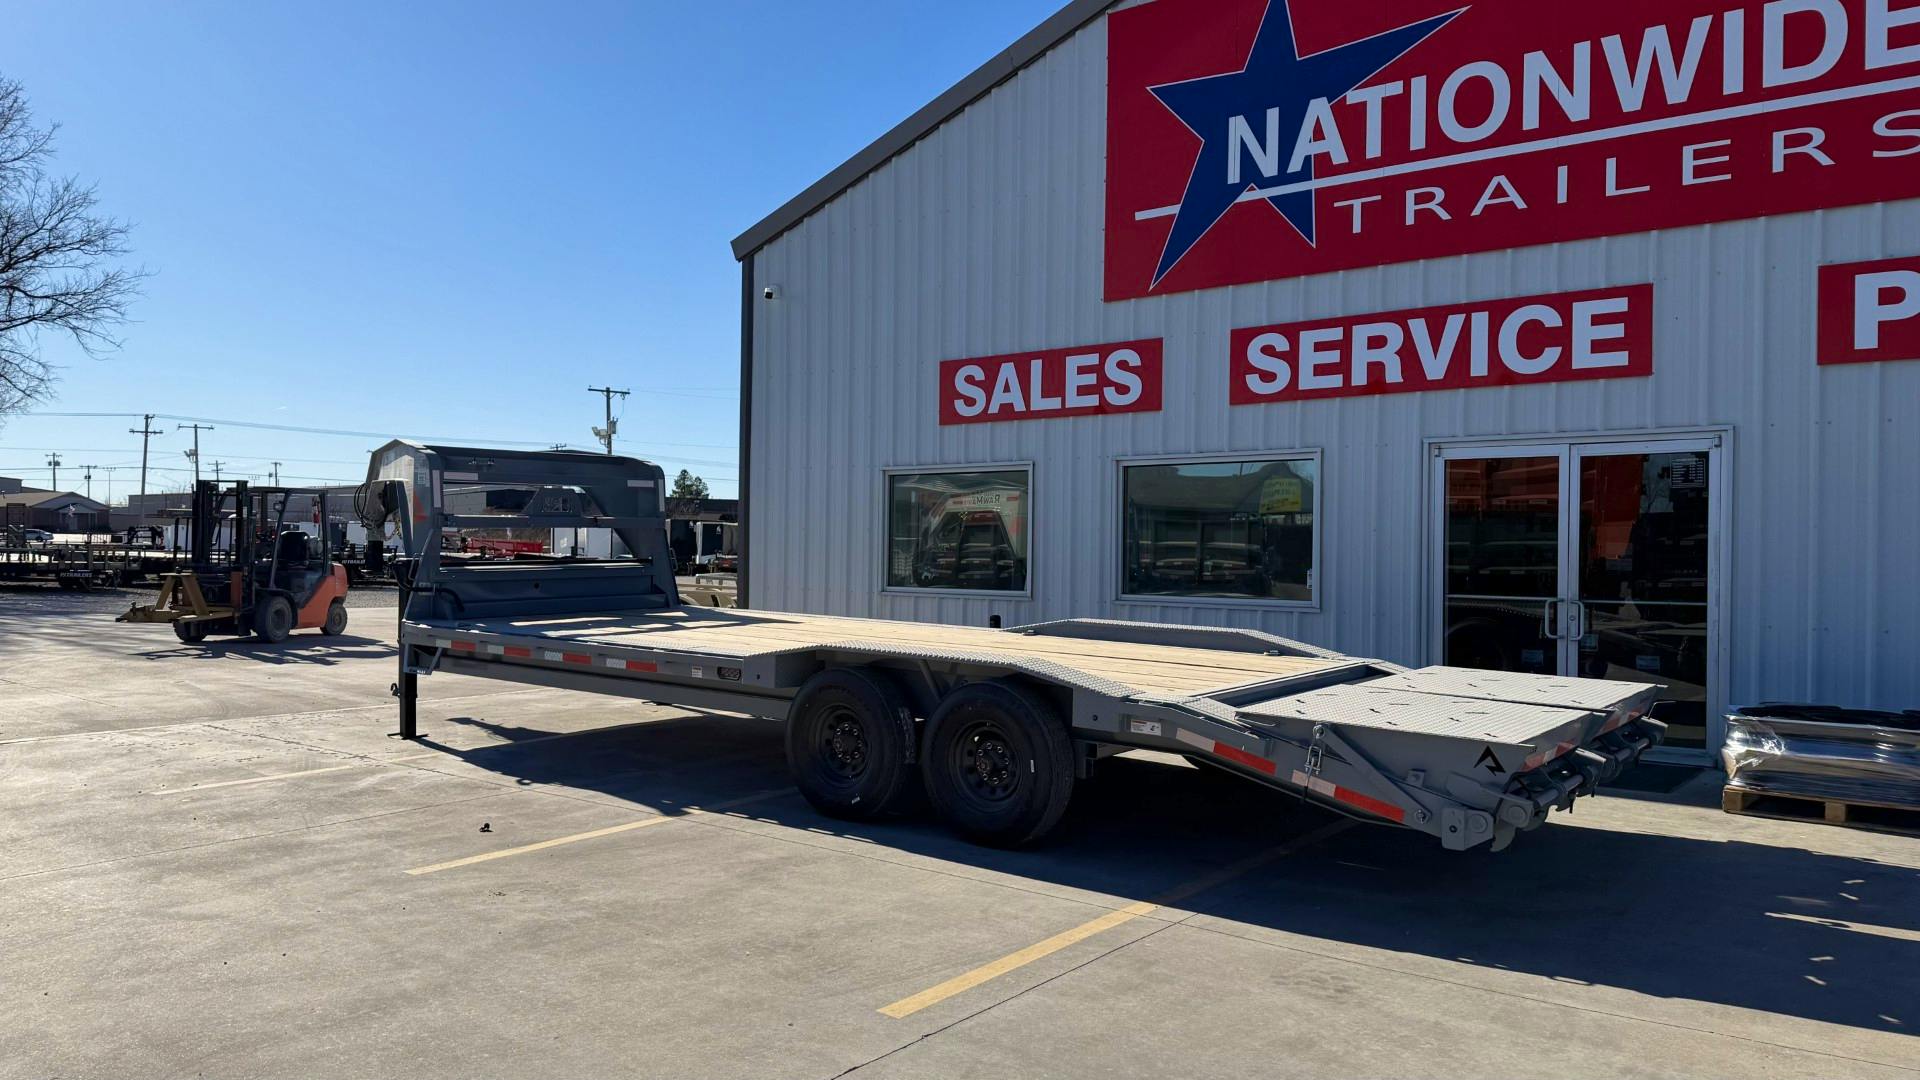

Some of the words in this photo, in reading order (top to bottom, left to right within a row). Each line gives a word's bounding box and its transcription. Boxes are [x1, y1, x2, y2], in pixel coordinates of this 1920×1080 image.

[1227, 0, 1920, 184] NATIONWIDE
[1334, 109, 1920, 233] TRAILERS
[953, 348, 1143, 417] SALES
[1245, 296, 1629, 395] SERVICE
